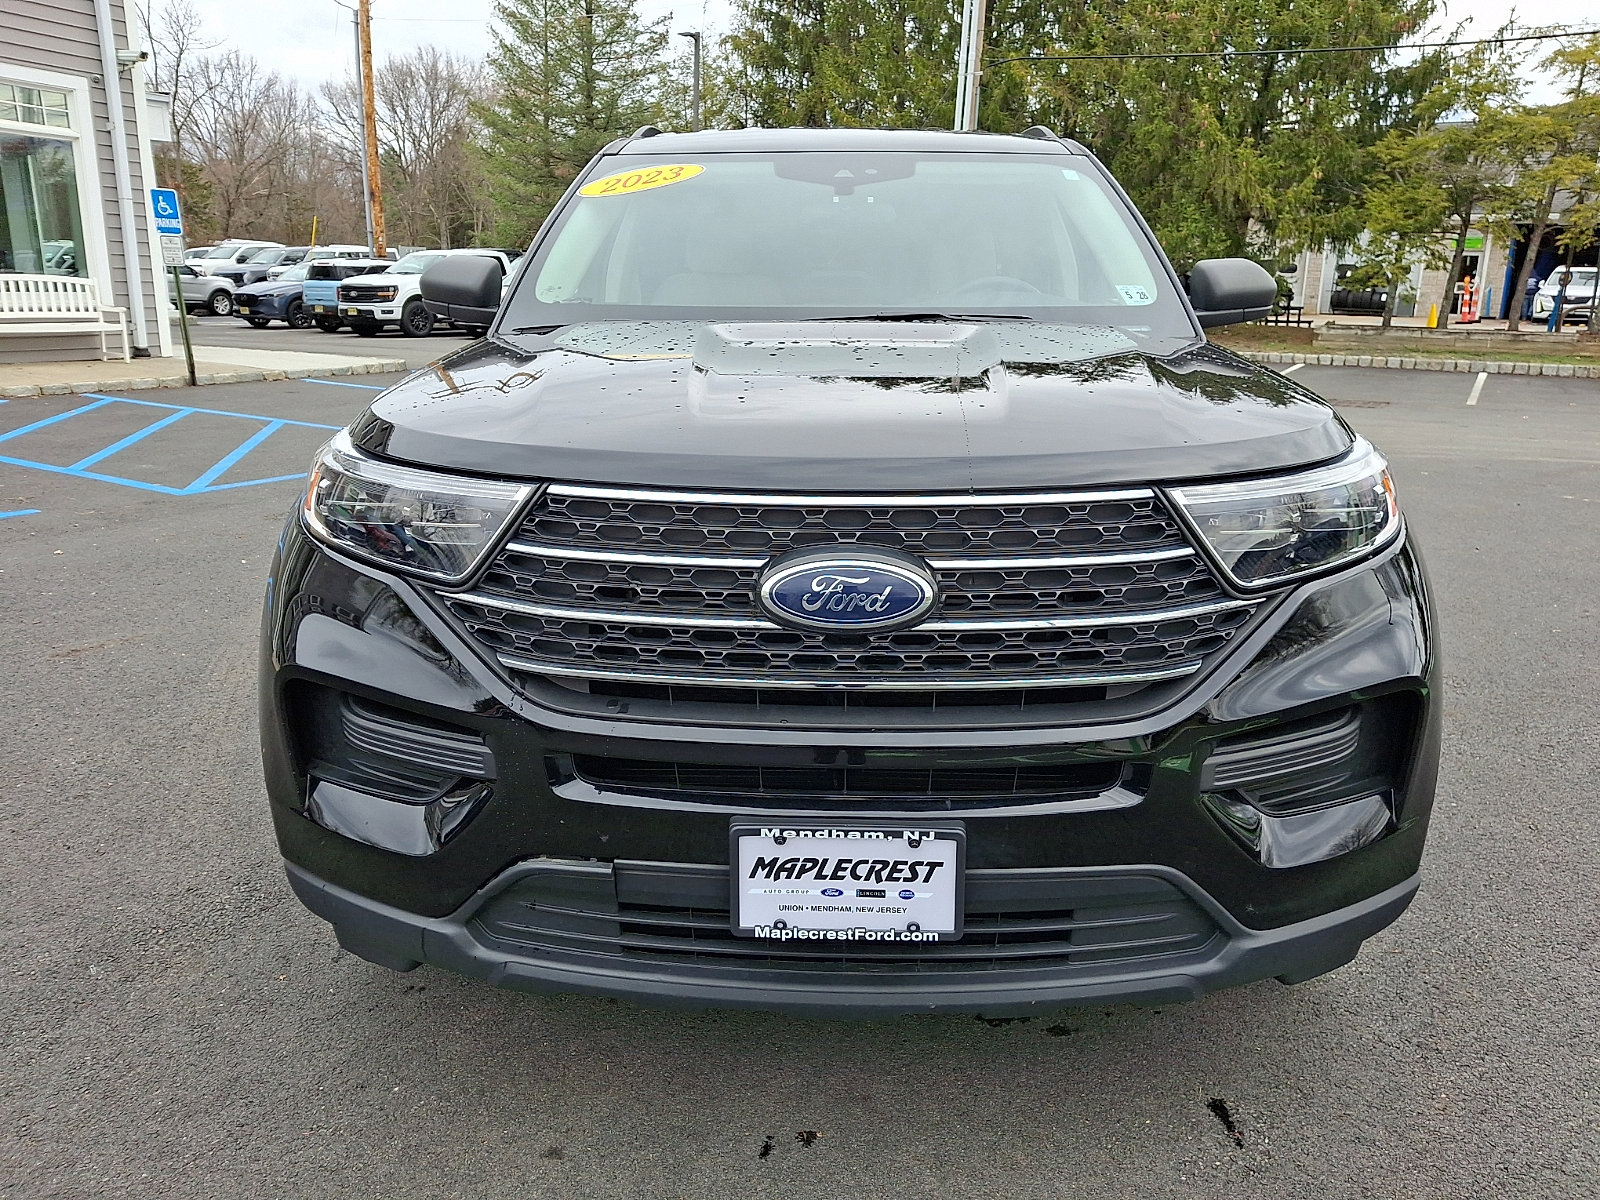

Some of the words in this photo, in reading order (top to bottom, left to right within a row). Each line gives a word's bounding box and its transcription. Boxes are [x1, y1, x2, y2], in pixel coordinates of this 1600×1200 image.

[599, 166, 685, 194] 2023
[155, 217, 181, 228] PARKING
[801, 574, 893, 612] Ford
[760, 828, 893, 842] Mendham,
[903, 830, 936, 841] NJ
[748, 856, 944, 885] MAPLECREST
[778, 904, 804, 912] UNION
[810, 905, 854, 914] MENDHAM,
[753, 925, 939, 942] MaplecrestFord.com
